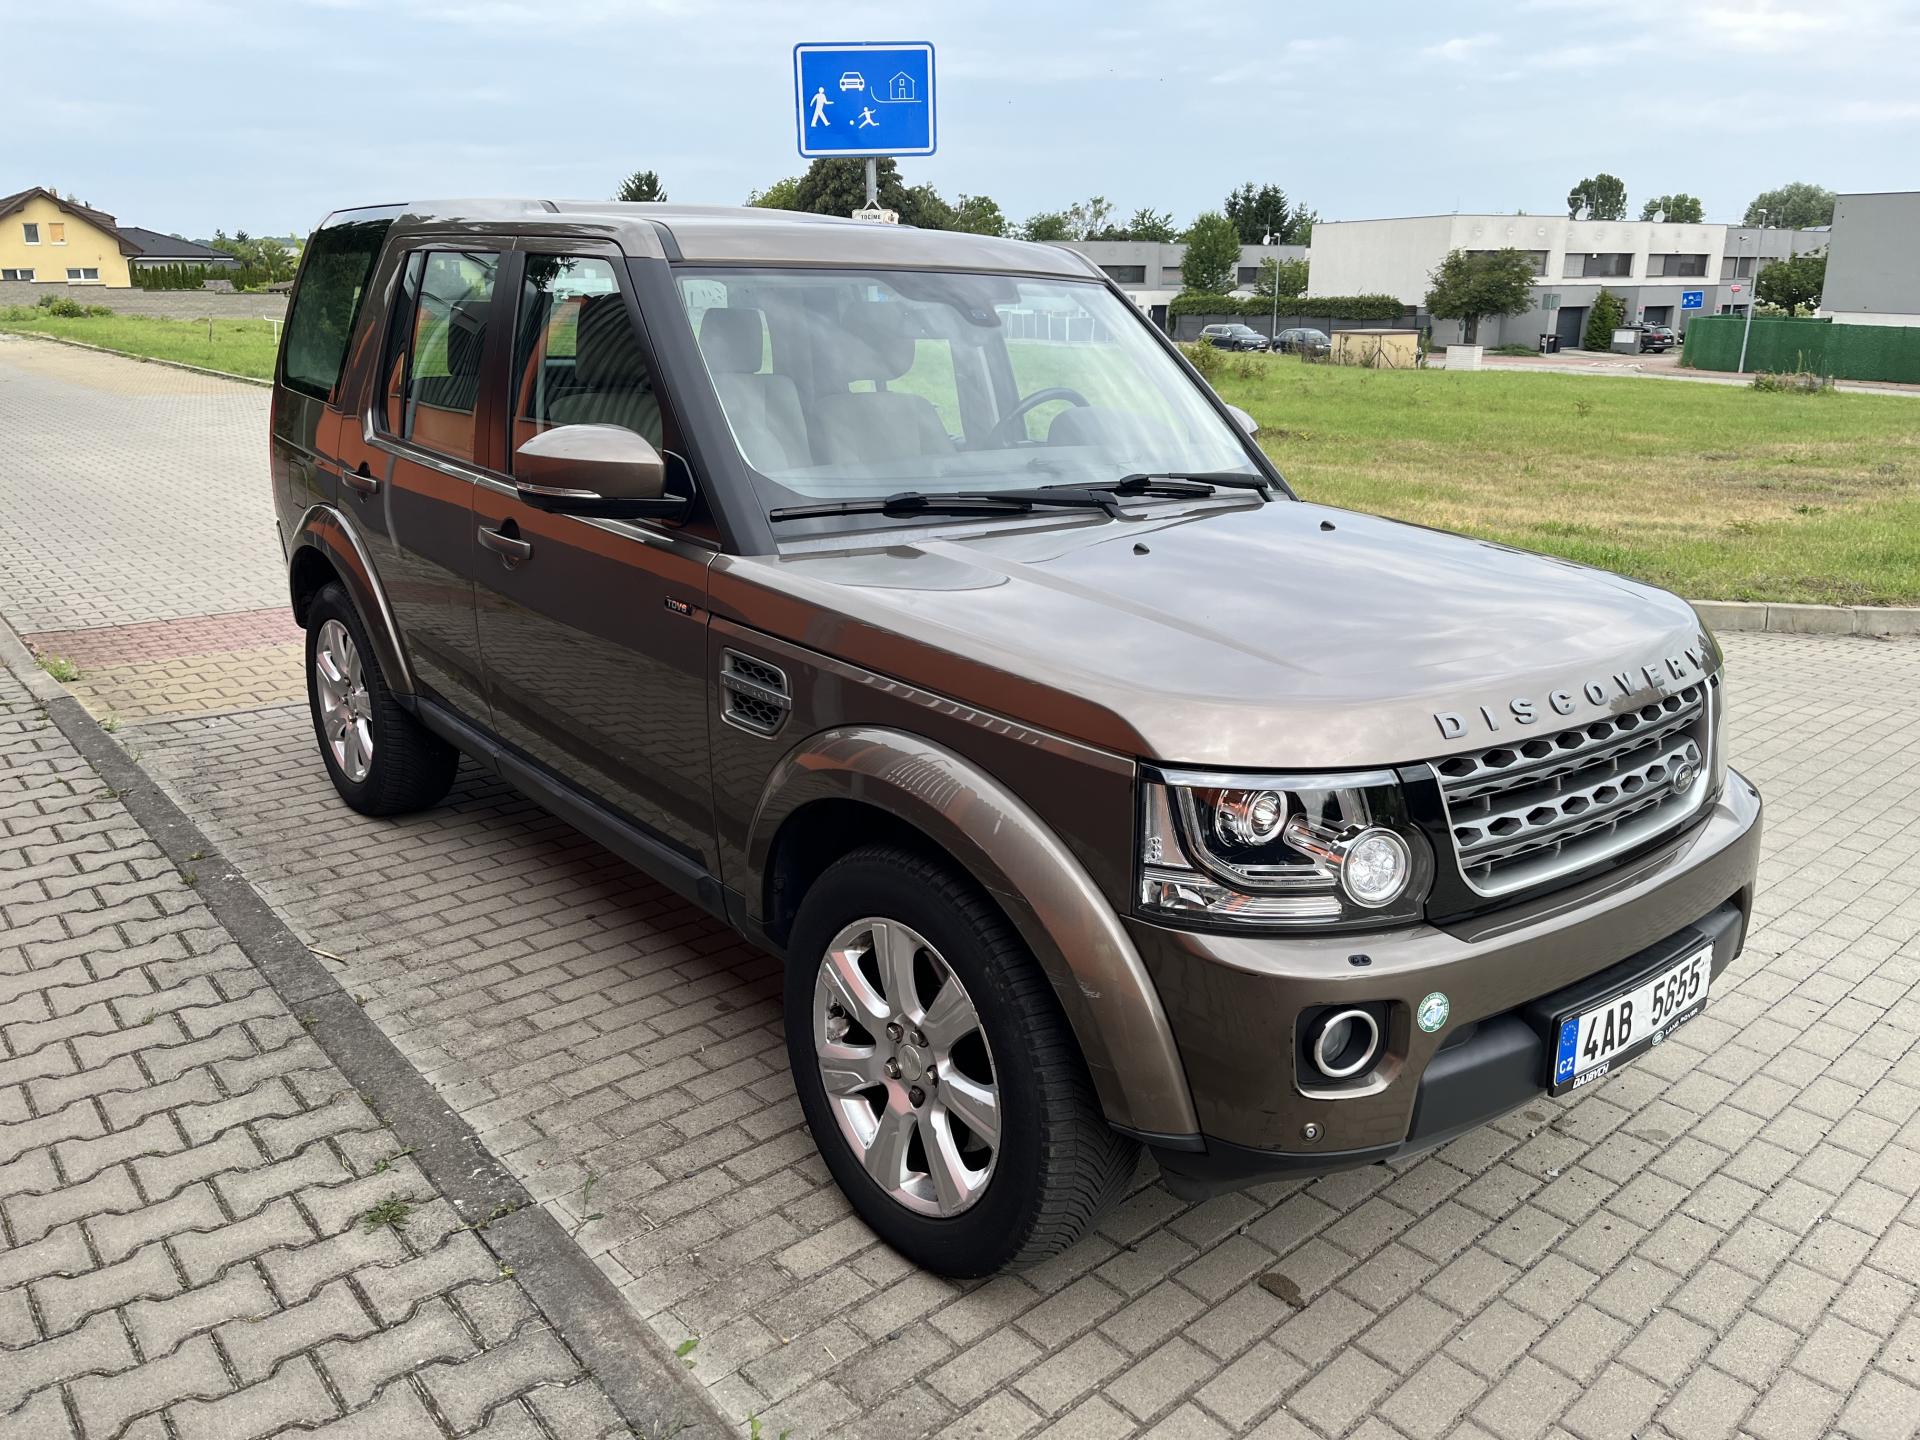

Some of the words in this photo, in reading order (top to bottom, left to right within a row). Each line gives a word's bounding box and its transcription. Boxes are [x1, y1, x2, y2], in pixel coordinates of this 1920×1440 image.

[1433, 647, 1704, 739] DISCOVERY
[1583, 1000, 1634, 1061] 4AB
[1651, 956, 1702, 1026] 5655
[1559, 1056, 1574, 1075] CZ
[1572, 1062, 1610, 1090] DAJBYCH
